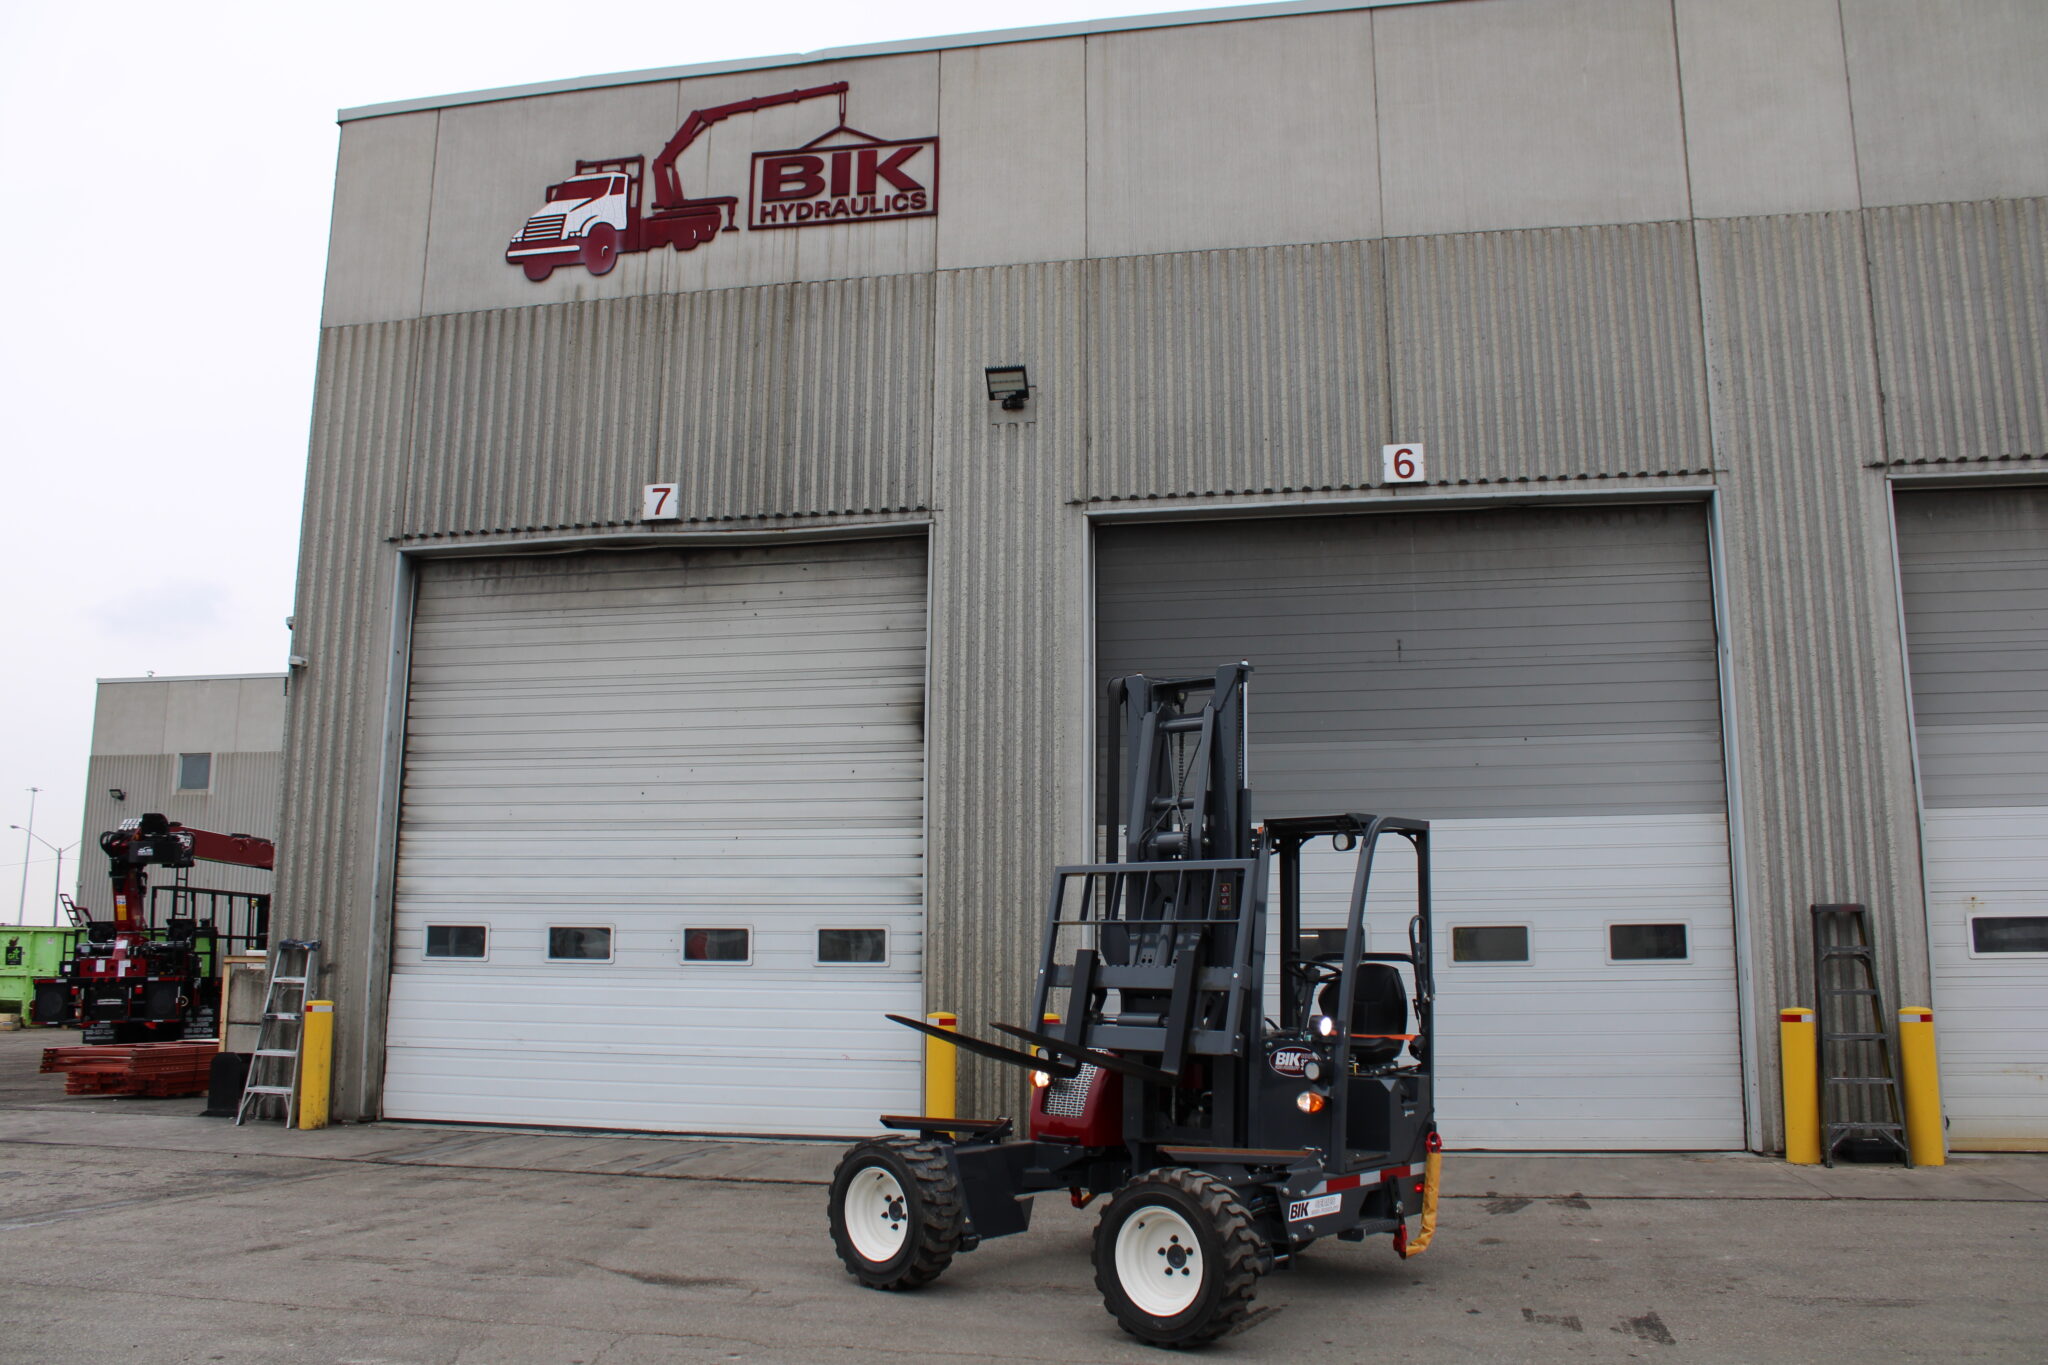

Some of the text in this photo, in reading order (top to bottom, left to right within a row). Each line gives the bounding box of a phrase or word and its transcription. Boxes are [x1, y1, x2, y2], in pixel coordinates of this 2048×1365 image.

[761, 145, 926, 203] BIK
[760, 191, 927, 224] HYDRAULICS
[1394, 448, 1415, 479] 6
[652, 487, 671, 516] 7
[1275, 1051, 1301, 1066] BIK
[1290, 1201, 1310, 1219] BIK
